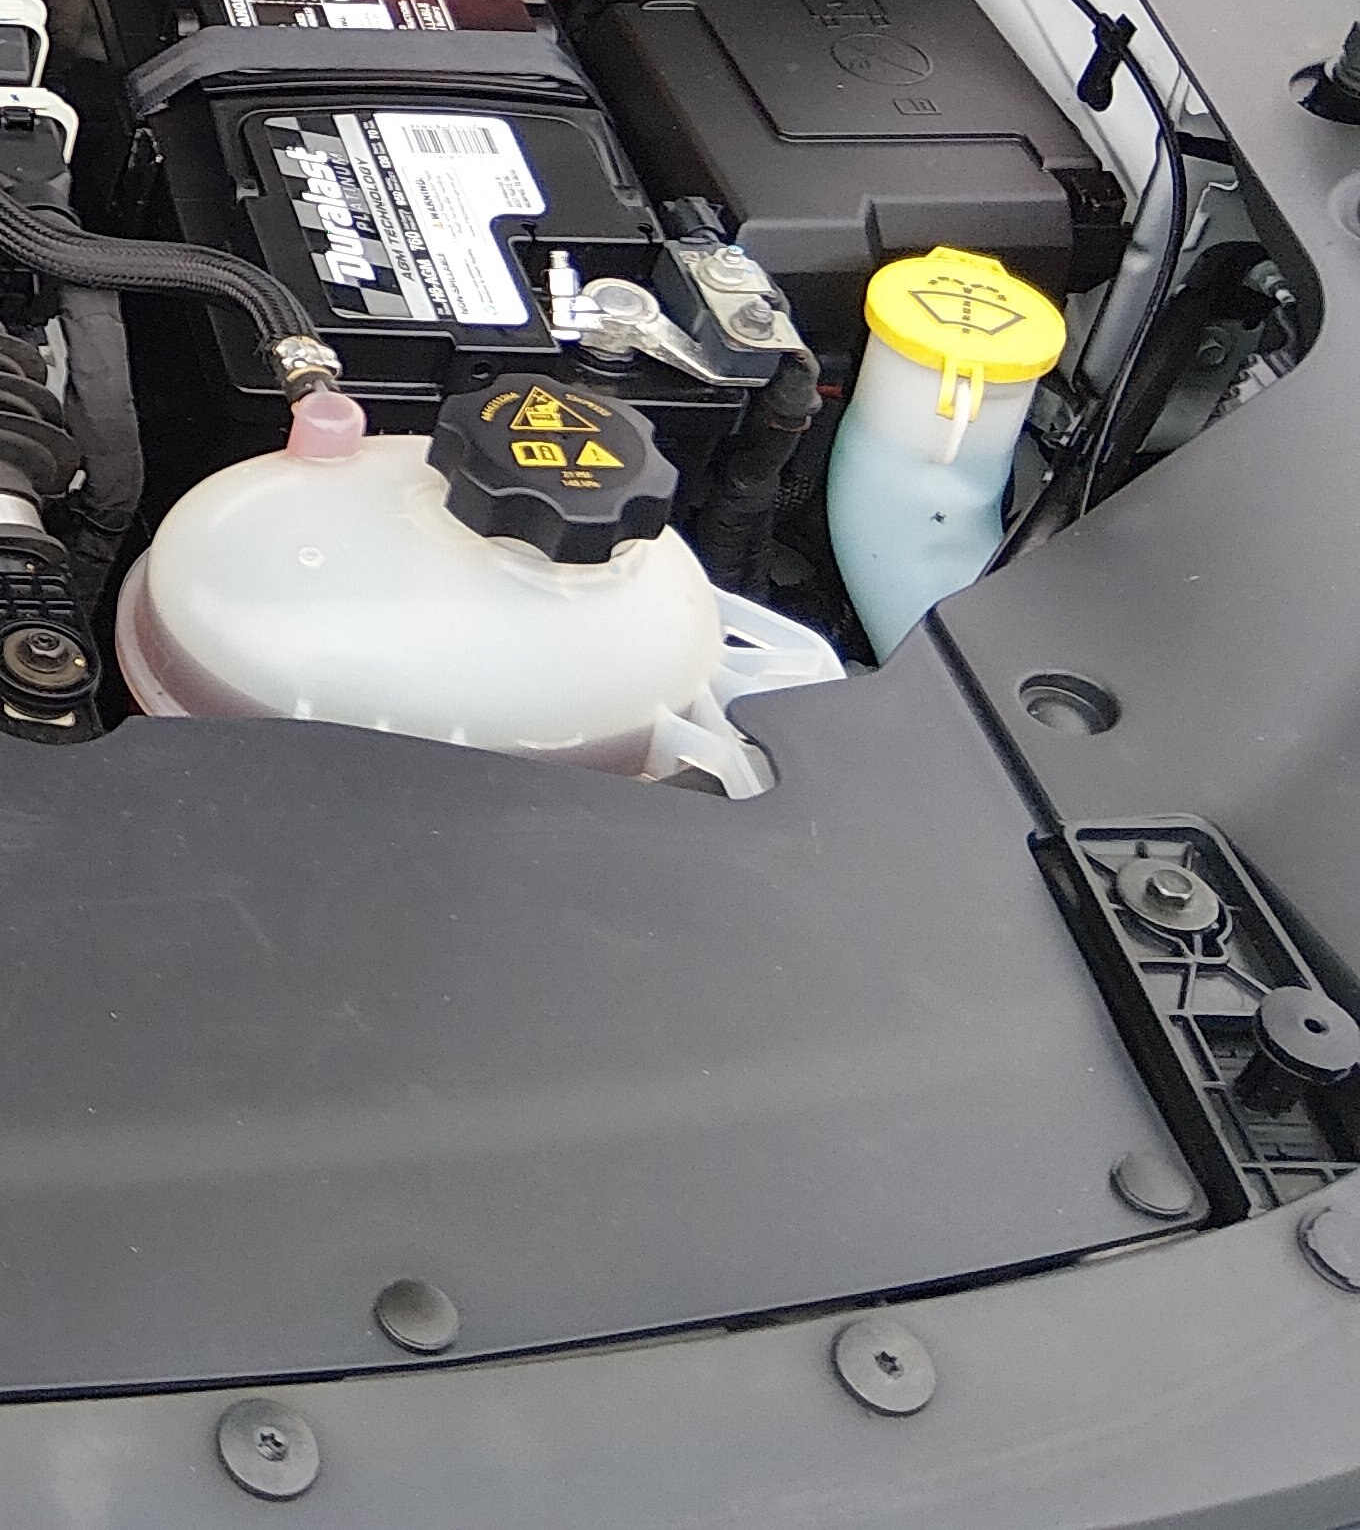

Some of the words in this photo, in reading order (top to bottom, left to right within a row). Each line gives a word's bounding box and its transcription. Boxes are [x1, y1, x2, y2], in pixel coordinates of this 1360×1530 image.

[285, 146, 377, 285] Duralast
[328, 151, 378, 234] PLATINUM
[354, 157, 401, 245] TECHNOLOGY
[396, 249, 416, 282] AGM
